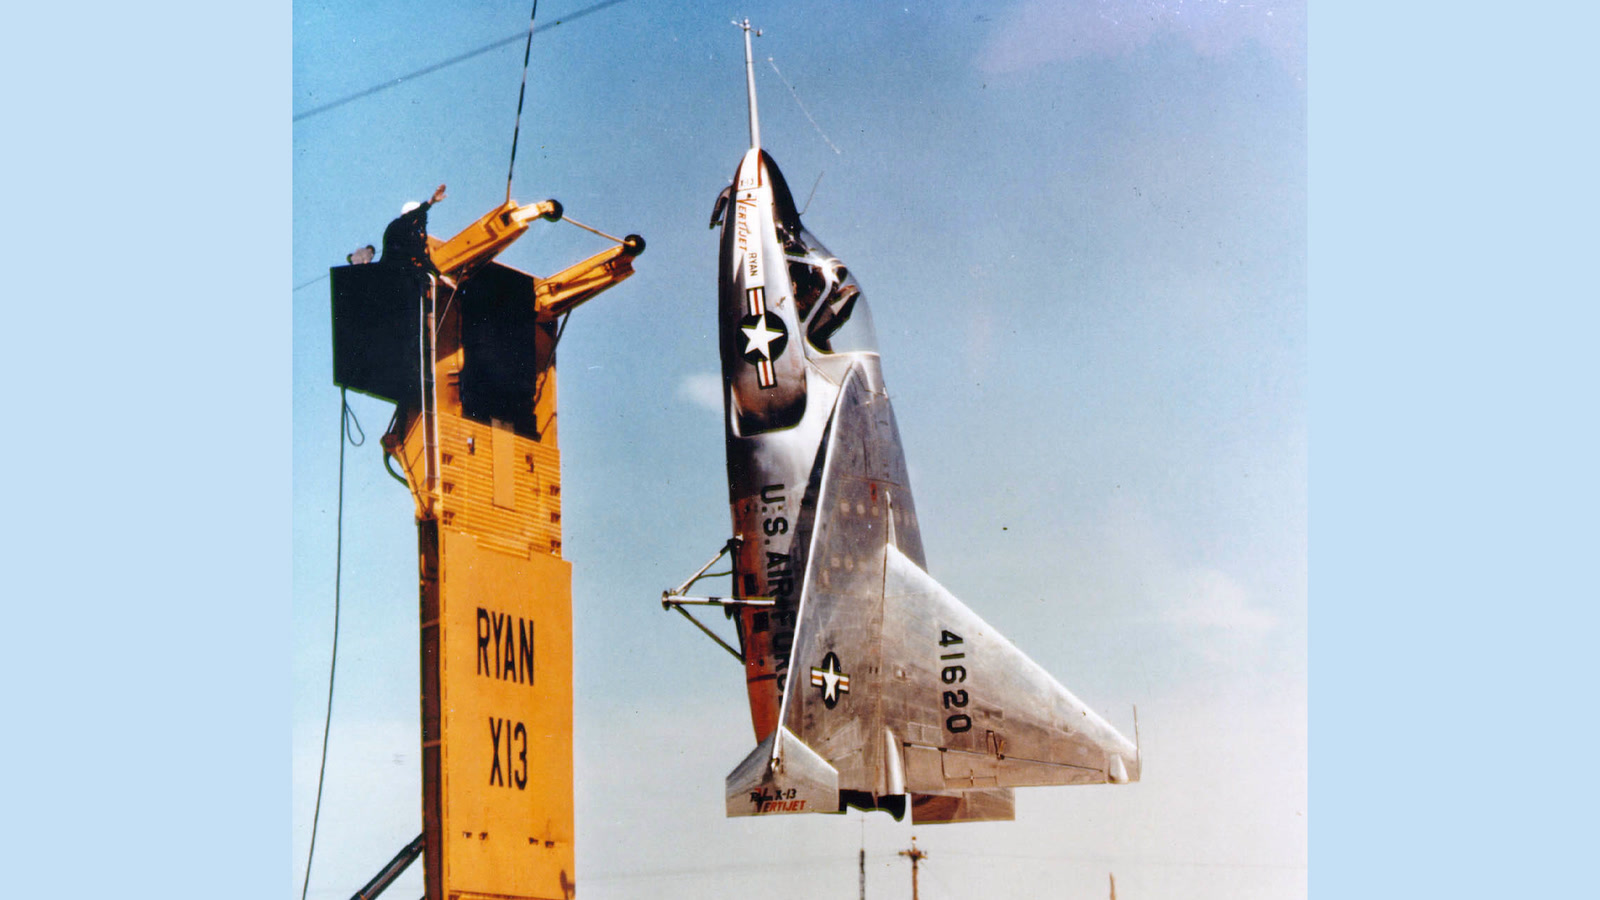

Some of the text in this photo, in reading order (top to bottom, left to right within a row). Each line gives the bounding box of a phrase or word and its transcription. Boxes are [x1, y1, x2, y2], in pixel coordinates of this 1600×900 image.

[737, 198, 757, 252] VERTIJET
[748, 252, 758, 277] RYAN
[761, 483, 788, 545] U.S.
[766, 551, 794, 597] AIR
[477, 606, 535, 687] RYAN
[939, 629, 972, 734] 41620
[489, 716, 528, 791] X13
[754, 786, 806, 813] VERTIJET
[775, 788, 797, 801] X-13
